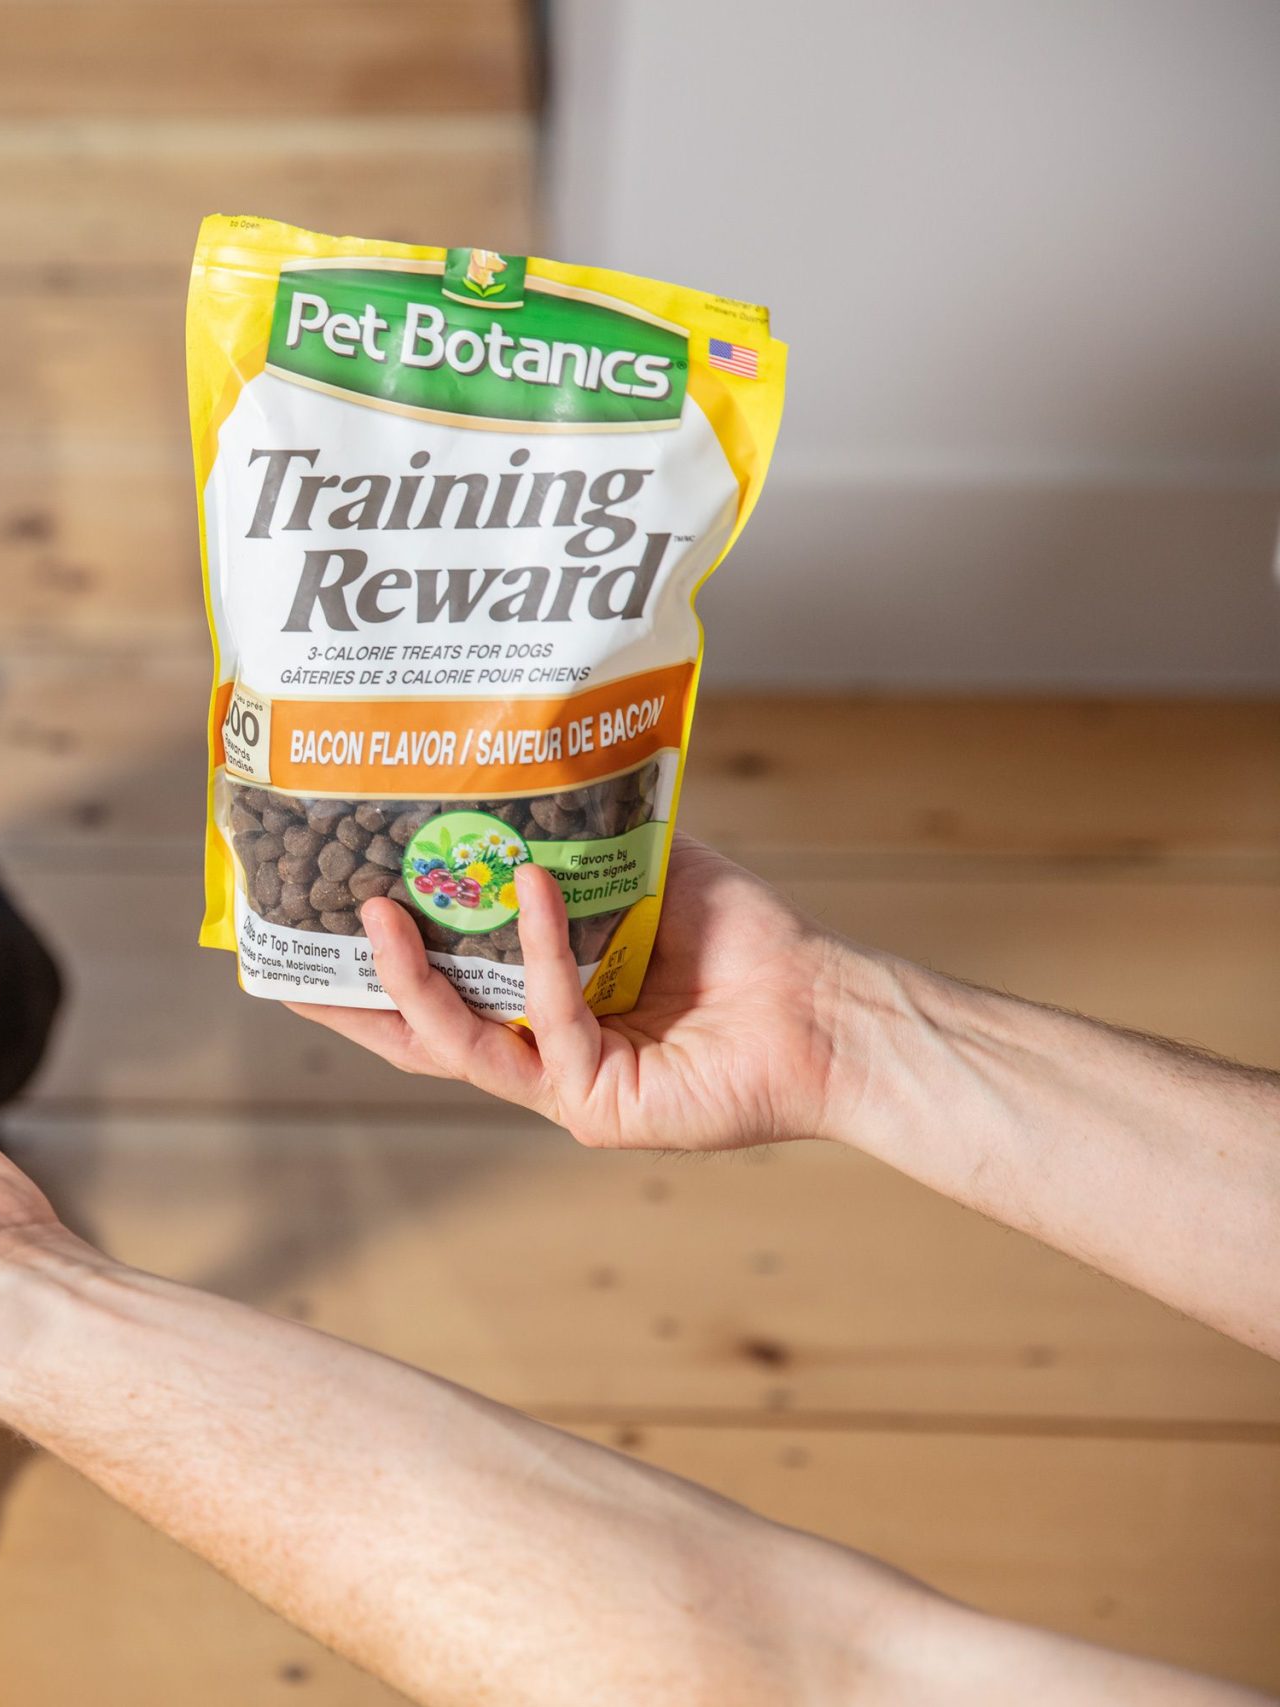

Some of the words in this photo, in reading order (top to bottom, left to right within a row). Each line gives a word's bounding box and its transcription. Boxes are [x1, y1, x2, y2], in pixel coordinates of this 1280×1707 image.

[285, 291, 390, 363] Pet
[399, 301, 674, 399] Botanics
[245, 448, 655, 559] Training
[280, 532, 673, 633] Reward
[307, 646, 397, 661] 3-CALORIE
[400, 645, 463, 660] TREATS
[466, 644, 502, 659] FOR
[504, 643, 554, 659] DOGS
[280, 666, 355, 685] GÂTERIES
[359, 670, 381, 685] DE
[386, 670, 396, 685] 3
[403, 669, 477, 685] CALORIE
[477, 668, 524, 684] POUR
[527, 667, 592, 683] CHIENS
[226, 700, 260, 747] 00
[289, 730, 365, 766] BACON
[369, 731, 458, 767] FLAVOR
[459, 729, 474, 766] /
[476, 726, 562, 766] SAVEUR
[567, 716, 595, 757] DE
[599, 695, 666, 748] BACON
[570, 853, 614, 866] Flavors
[616, 849, 628, 861] by
[549, 869, 600, 881] Saveurs
[562, 878, 639, 904] otaniFits
[256, 933, 268, 947] of
[270, 934, 289, 956] Top
[292, 940, 341, 960] Trainers
[354, 947, 368, 962] Le
[257, 952, 285, 969] Focus,
[286, 959, 337, 976] Motivation,
[431, 962, 484, 982] incipaux
[487, 968, 525, 990] dresse
[262, 969, 301, 986] Learning
[303, 975, 330, 987] Curve
